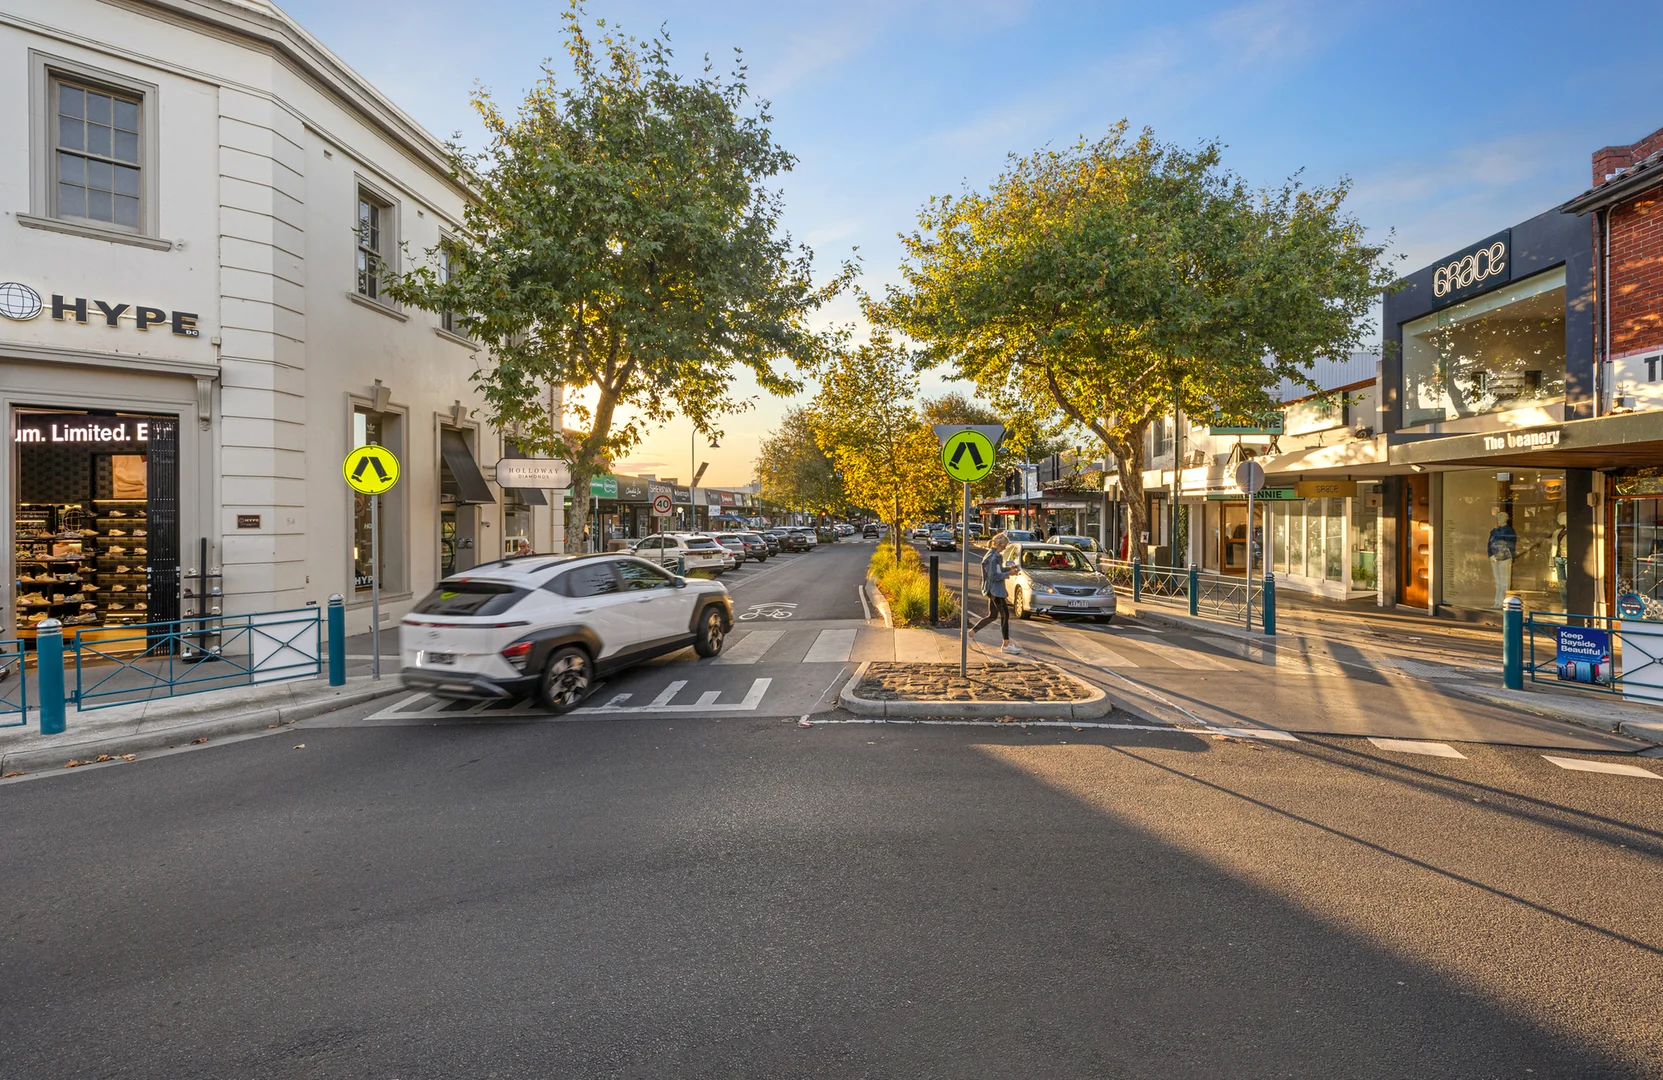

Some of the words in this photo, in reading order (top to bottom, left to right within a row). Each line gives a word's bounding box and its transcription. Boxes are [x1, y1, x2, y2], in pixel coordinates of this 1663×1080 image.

[51, 294, 199, 336] HYPE
[51, 423, 131, 442] Limited.
[1483, 436, 1505, 450] The
[1507, 430, 1560, 449] beanery
[656, 499, 669, 509] 40
[355, 575, 373, 585] HYP
[1560, 631, 1584, 640] Keep
[1561, 638, 1596, 648] Bayside
[1561, 645, 1601, 656] Beautiful
